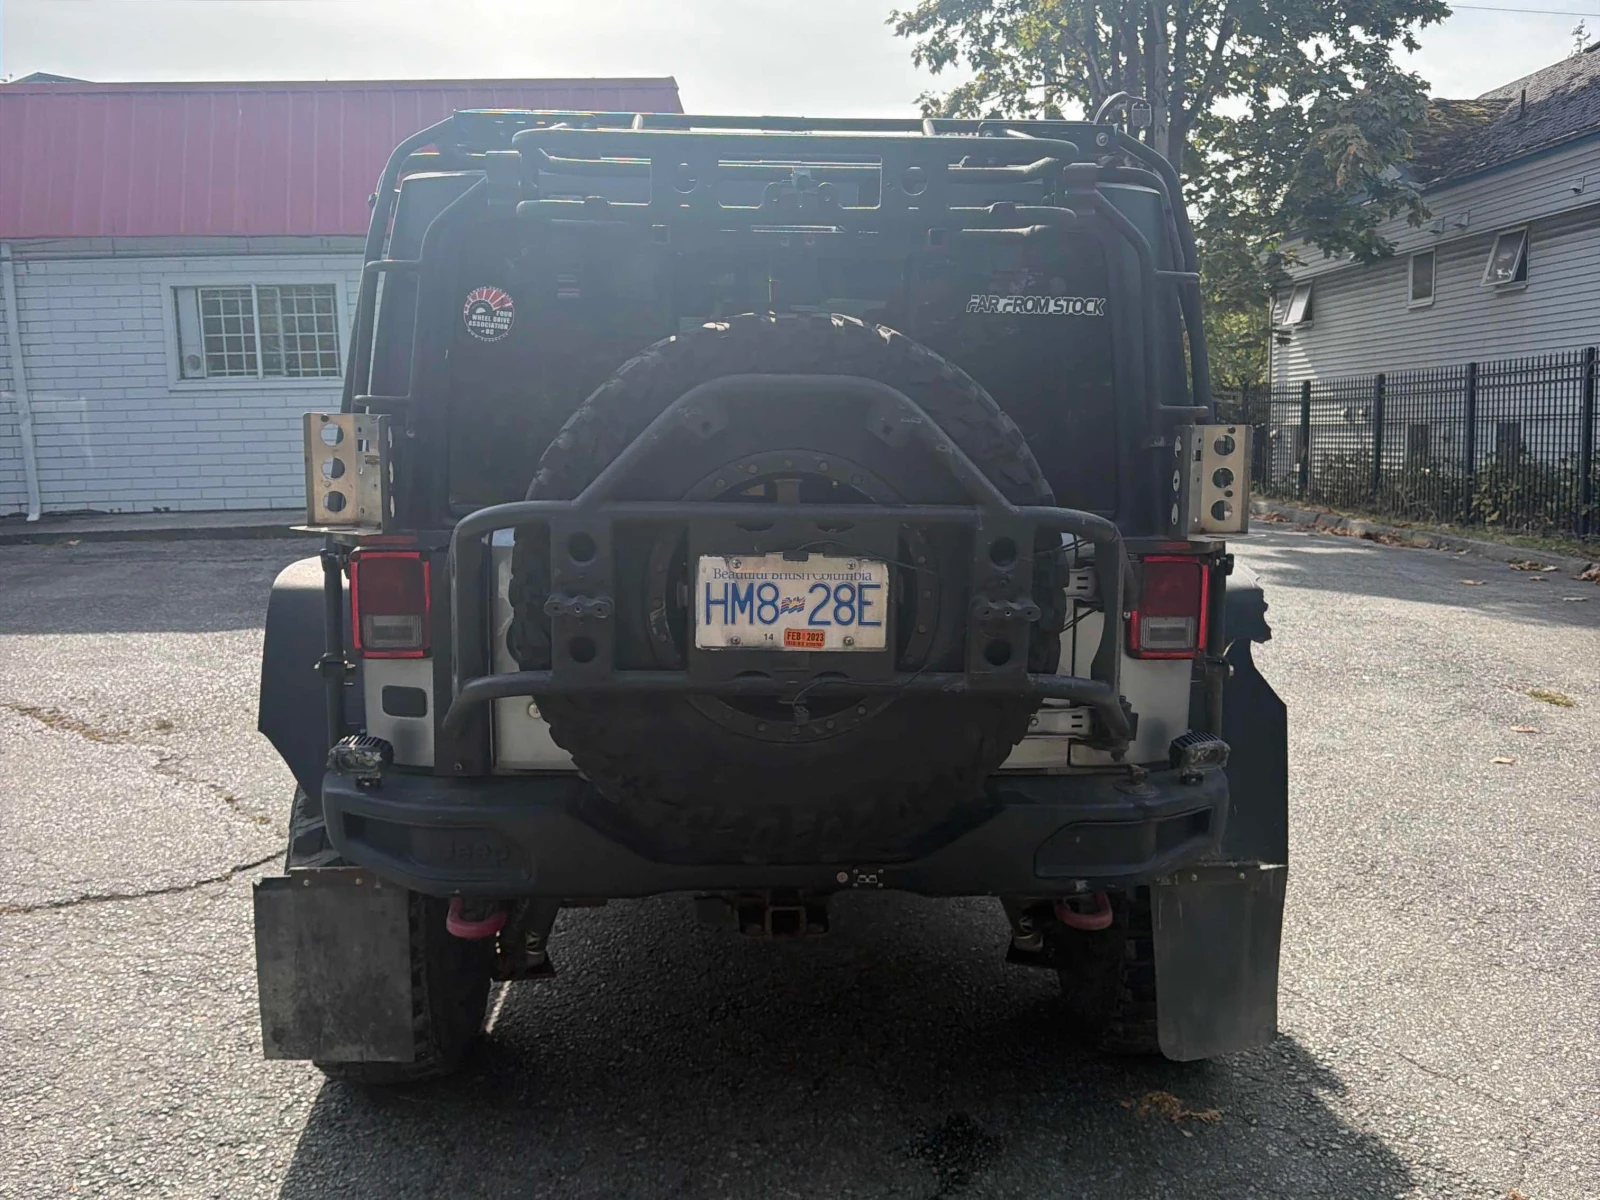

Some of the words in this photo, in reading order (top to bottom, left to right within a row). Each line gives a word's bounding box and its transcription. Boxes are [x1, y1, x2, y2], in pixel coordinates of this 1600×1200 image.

[966, 295, 1000, 313] FAR
[1002, 296, 1051, 314] FROM
[1052, 297, 1106, 316] STOCK
[472, 314, 492, 322] WHEEL
[492, 316, 510, 324] DRIVE
[496, 310, 512, 318] FOUR
[468, 320, 509, 330] ASSOCIATION
[705, 582, 780, 626] HM8
[807, 582, 882, 627] 28E
[763, 633, 774, 641] 14
[786, 631, 802, 641] FEB
[807, 632, 824, 642] 2023
